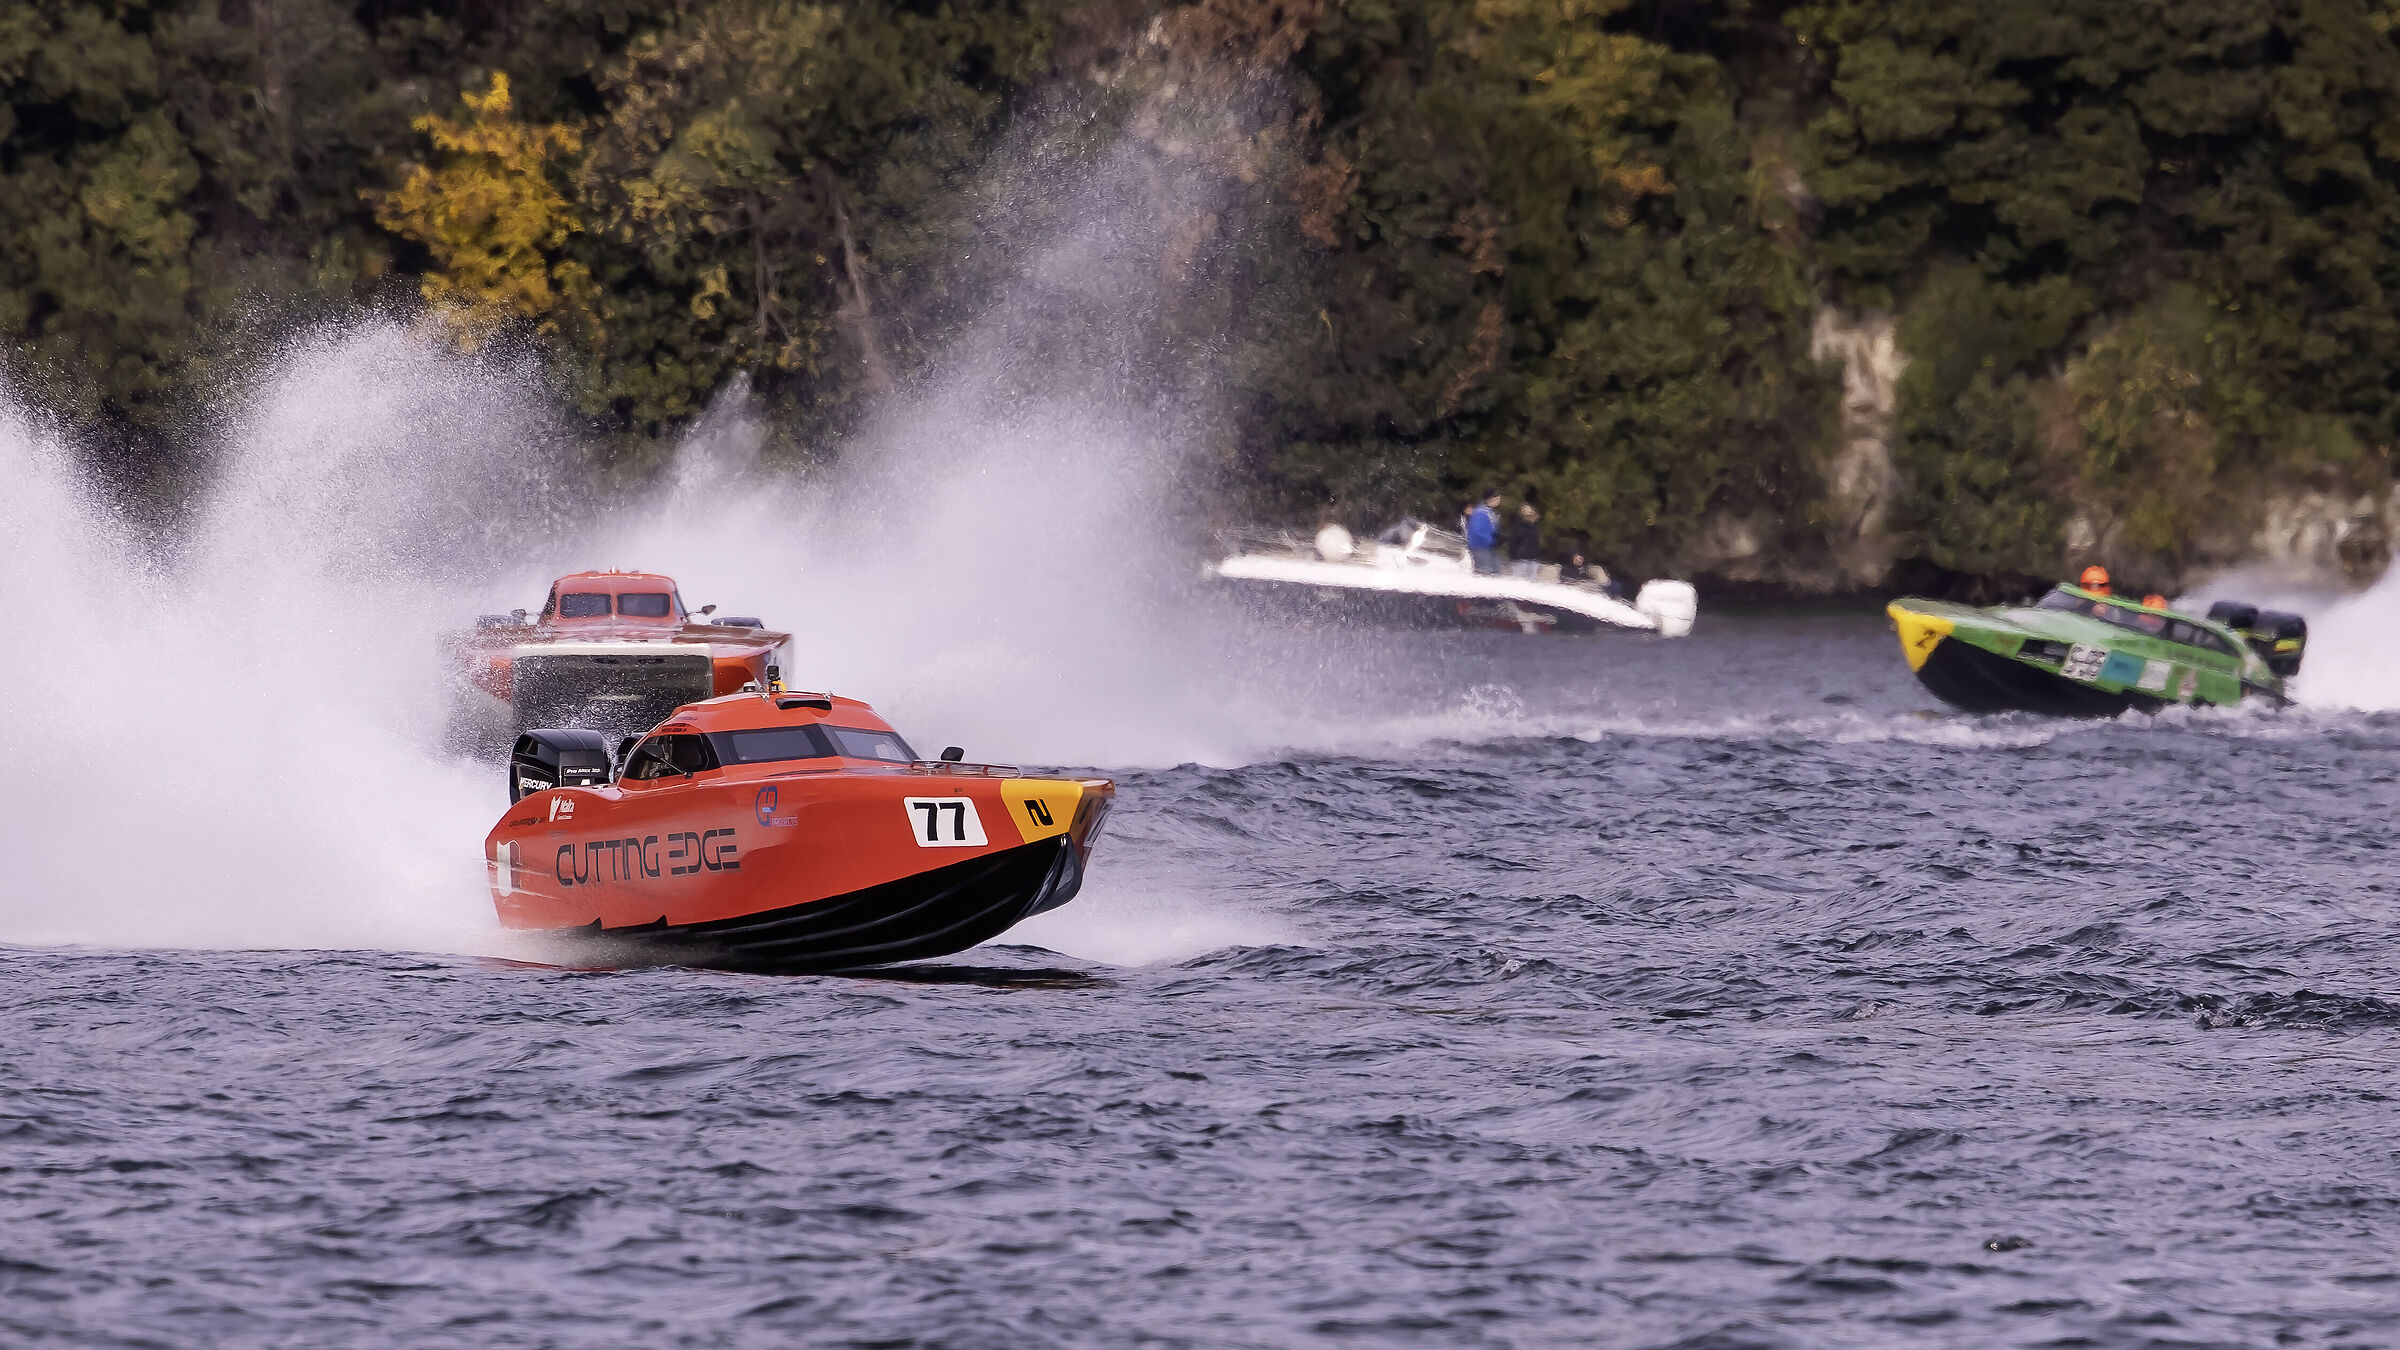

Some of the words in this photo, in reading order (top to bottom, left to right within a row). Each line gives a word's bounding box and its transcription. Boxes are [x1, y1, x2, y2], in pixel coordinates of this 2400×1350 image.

[520, 776, 553, 791] MERCURY
[912, 801, 966, 842] 77
[556, 835, 661, 887] CUTTING
[667, 828, 741, 876] EDGE
